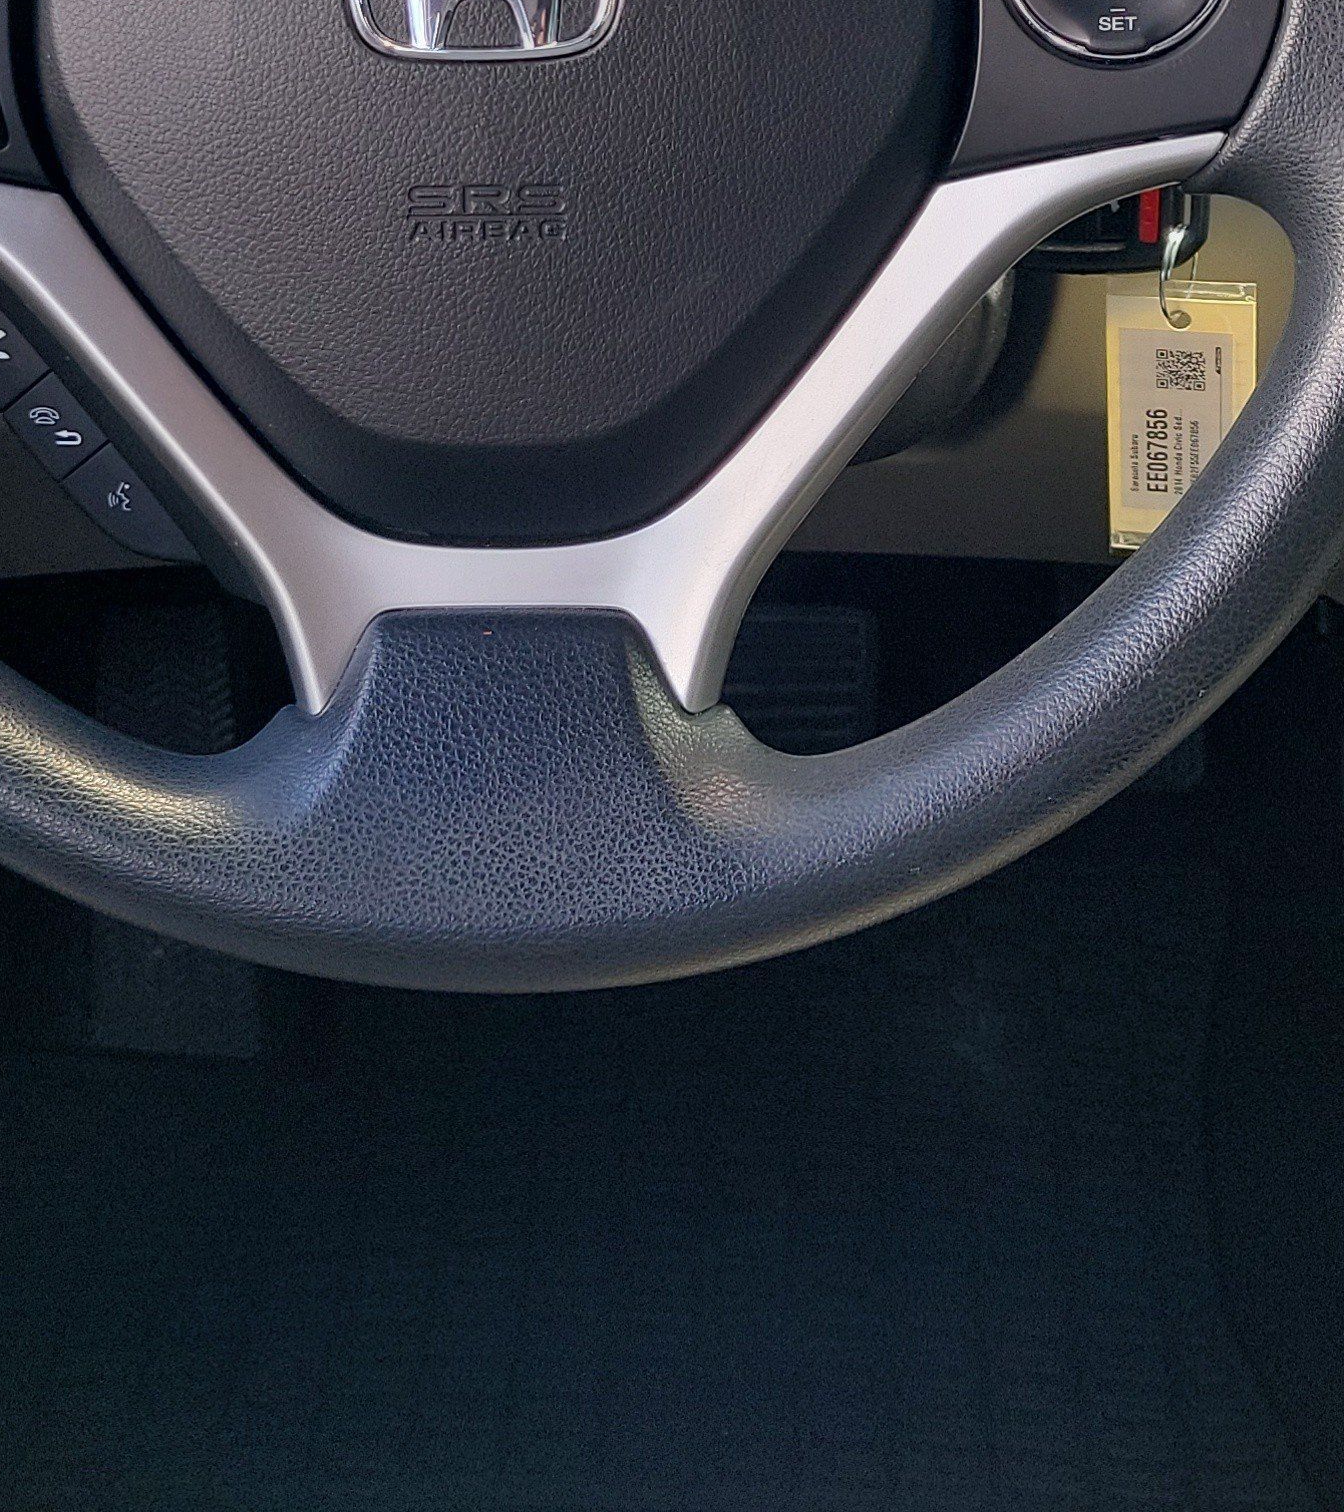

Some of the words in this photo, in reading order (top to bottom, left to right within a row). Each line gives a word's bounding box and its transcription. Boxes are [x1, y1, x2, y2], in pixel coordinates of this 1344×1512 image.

[1098, 15, 1138, 32] SET
[408, 185, 567, 215] SRS
[408, 219, 567, 242] AIRBAG
[1146, 409, 1168, 493] EE067856
[1174, 451, 1183, 476] Honda
